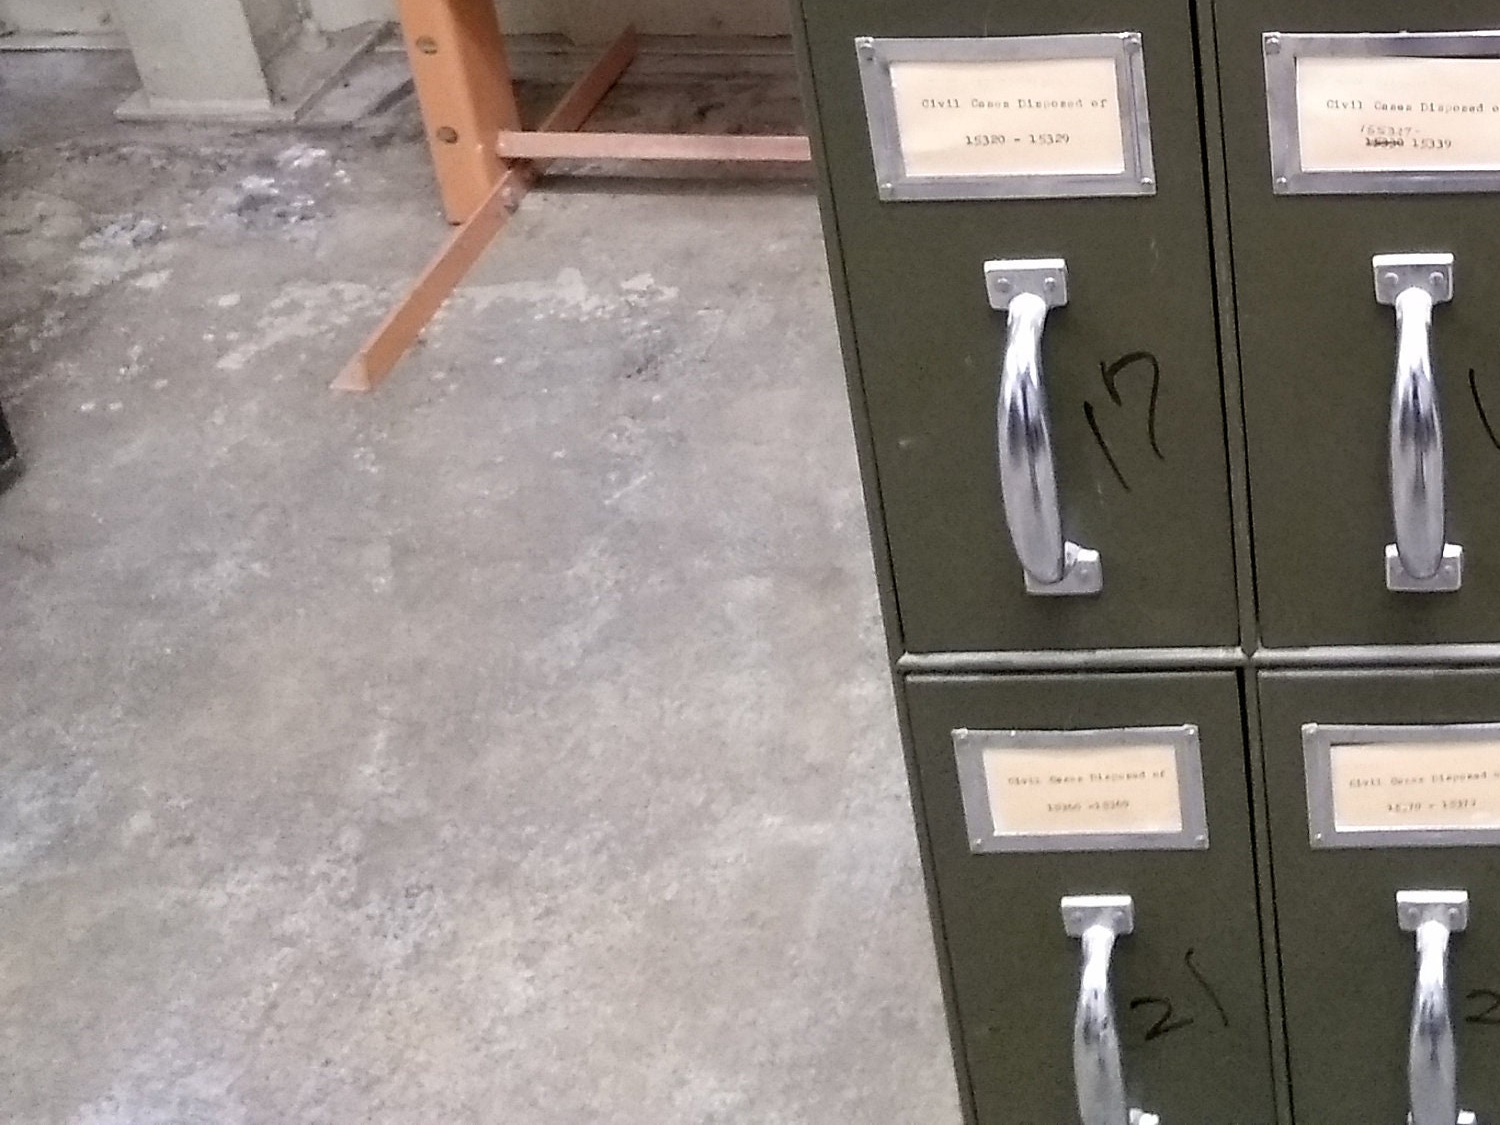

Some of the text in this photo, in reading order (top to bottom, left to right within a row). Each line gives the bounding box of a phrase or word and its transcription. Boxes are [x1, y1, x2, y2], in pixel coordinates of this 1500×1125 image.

[922, 98, 1107, 109] Civil Cases Disposed of
[1327, 99, 1362, 110] Civil
[1374, 101, 1412, 112] Cases
[1420, 102, 1483, 114] Disposed
[965, 134, 1005, 145] 15320
[1029, 134, 1070, 145] 15329
[1412, 137, 1452, 148] 15339
[1083, 351, 1165, 493] 17
[1130, 948, 1229, 1042] 21
